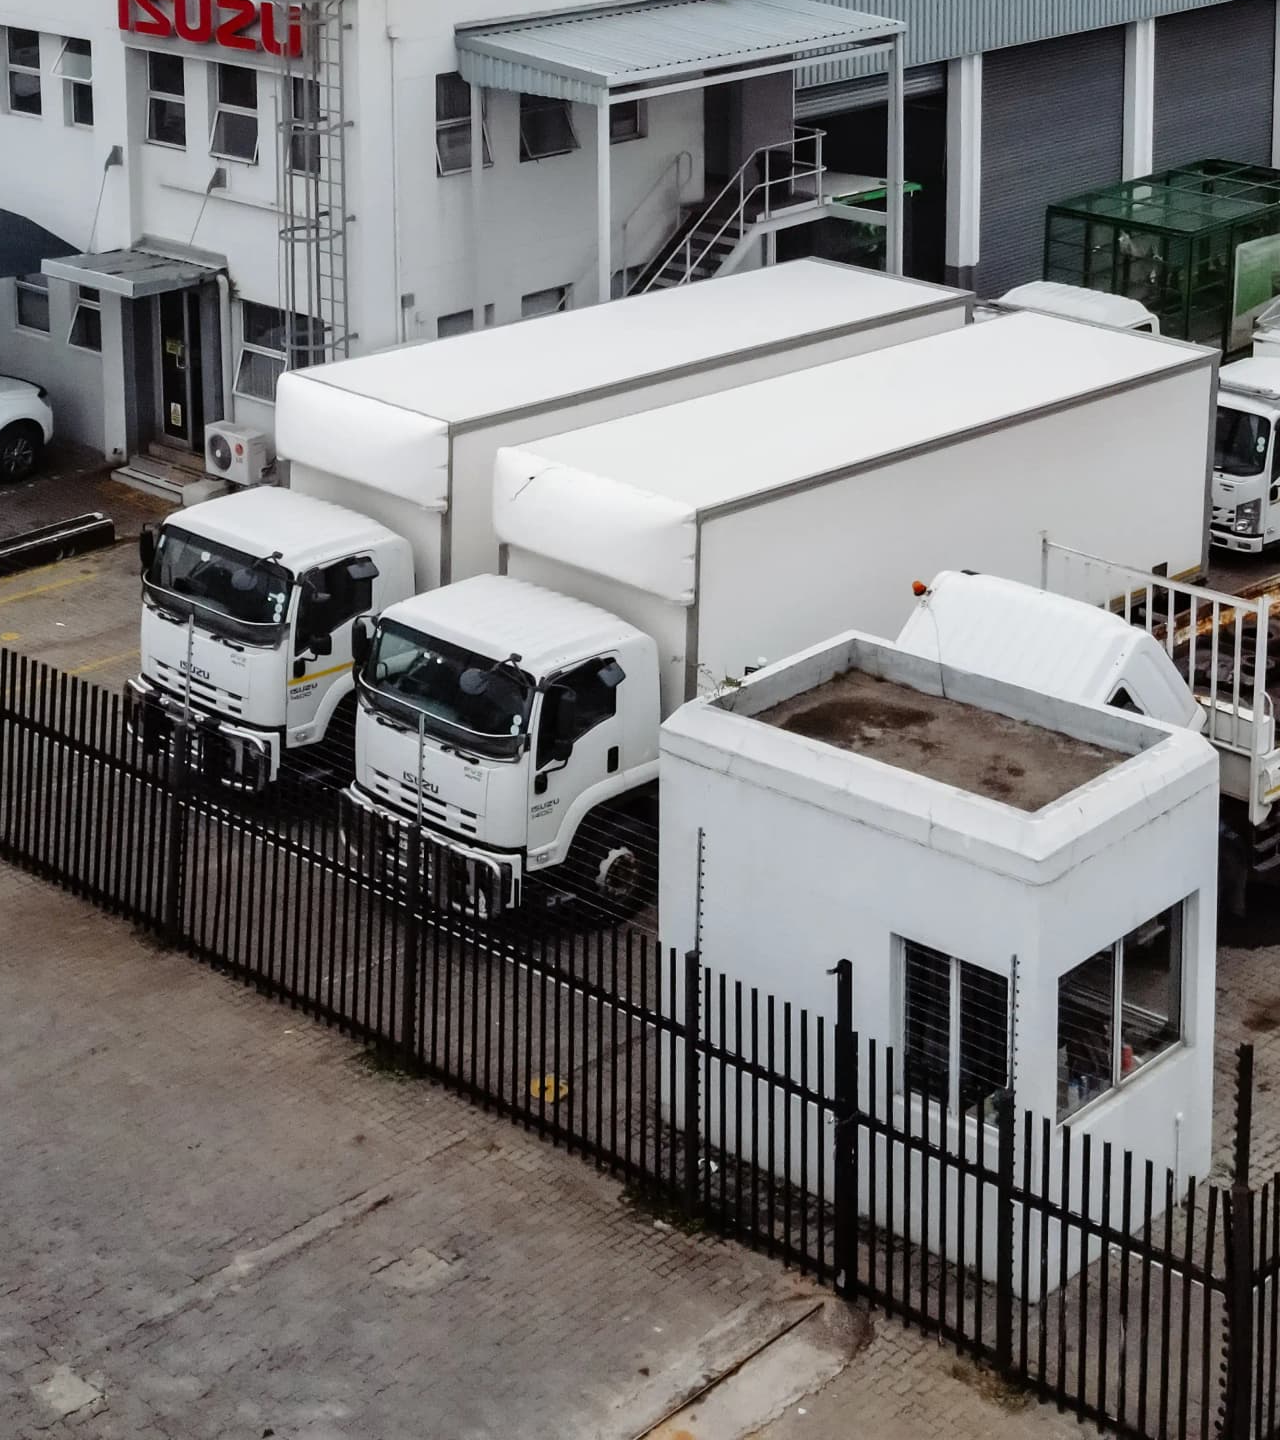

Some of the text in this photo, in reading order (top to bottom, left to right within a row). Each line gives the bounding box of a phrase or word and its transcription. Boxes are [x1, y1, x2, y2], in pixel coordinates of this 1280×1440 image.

[289, 682, 318, 696] ISUZU
[402, 771, 440, 795] ISUZU
[530, 798, 561, 814] ISUZU
